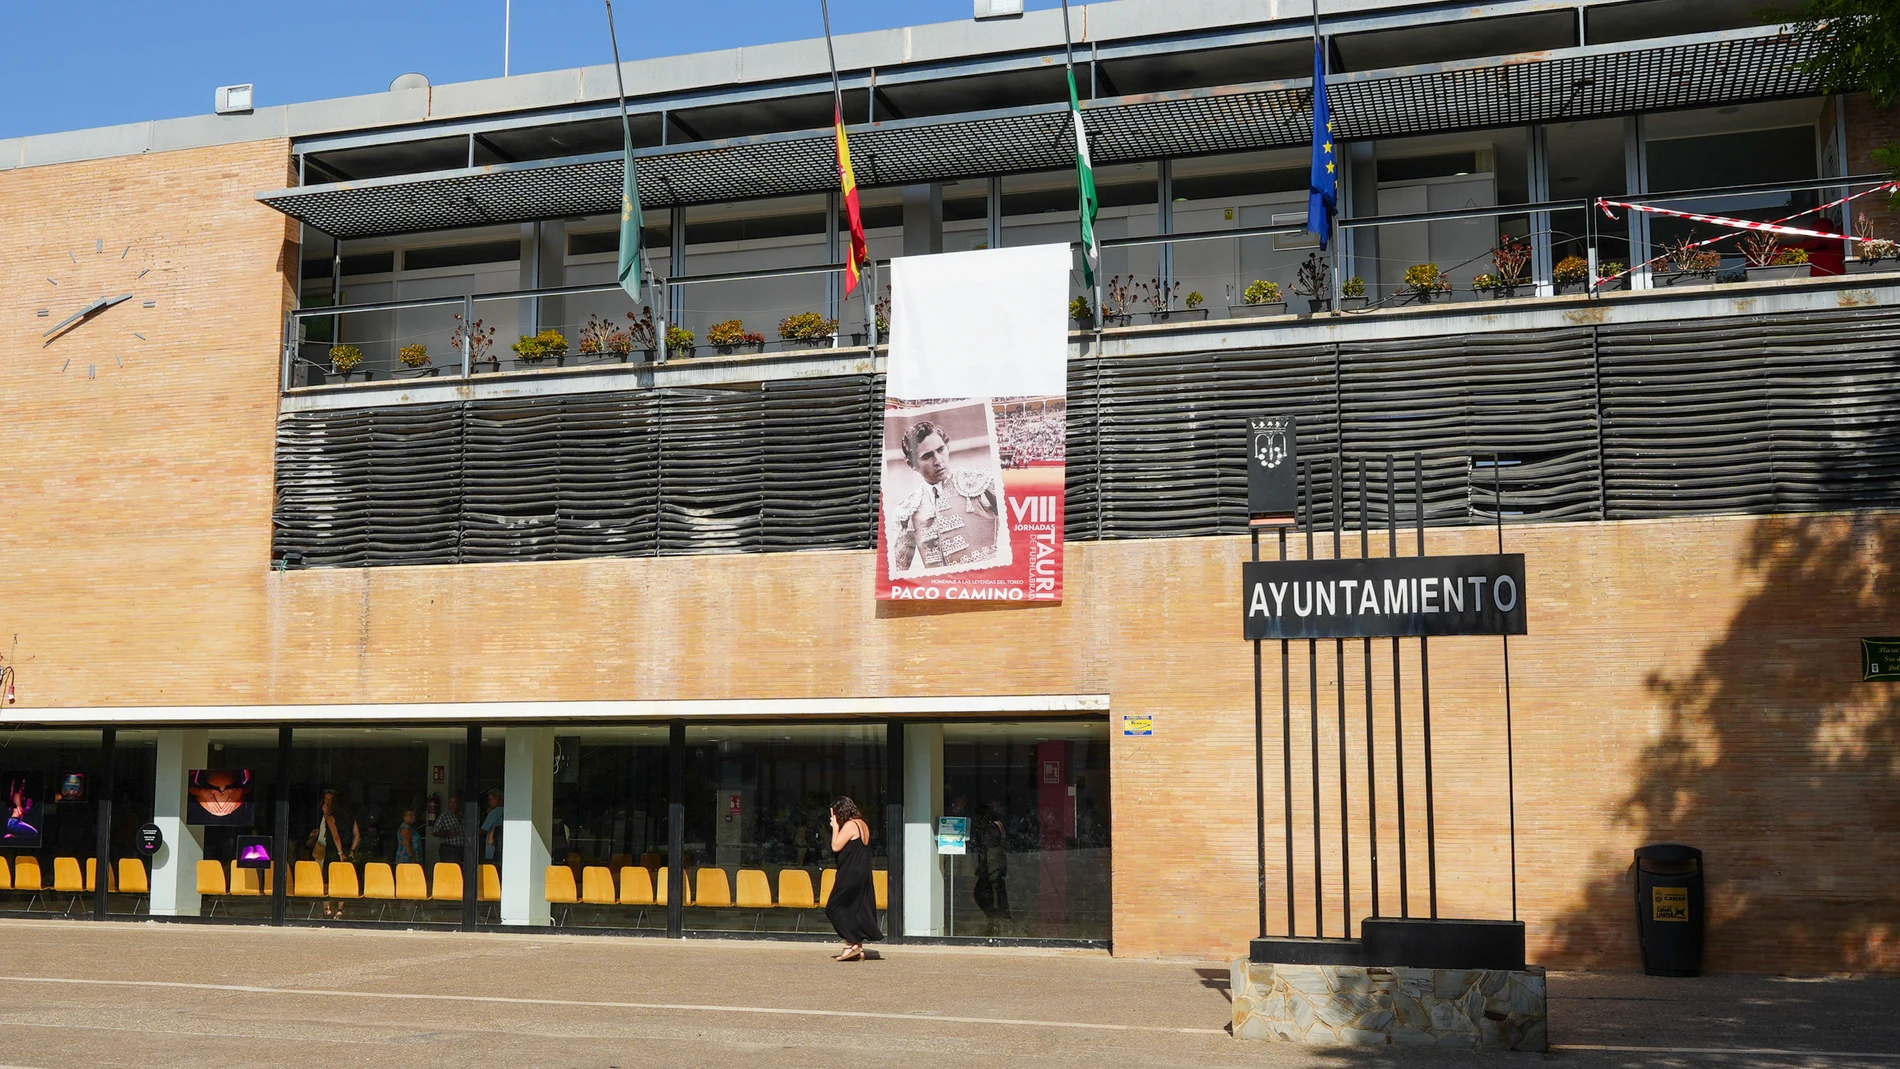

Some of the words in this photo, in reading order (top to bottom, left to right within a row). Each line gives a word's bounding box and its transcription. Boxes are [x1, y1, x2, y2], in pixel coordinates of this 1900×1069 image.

[1008, 496, 1056, 523] VIII
[1029, 534, 1037, 544] DE
[1028, 546, 1037, 600] FUENLABRAD
[1035, 529, 1056, 599] TAURI
[891, 586, 940, 600] PACO
[945, 587, 1023, 600] CAMINO
[1249, 575, 1517, 617] AYUNTAMIENTO
